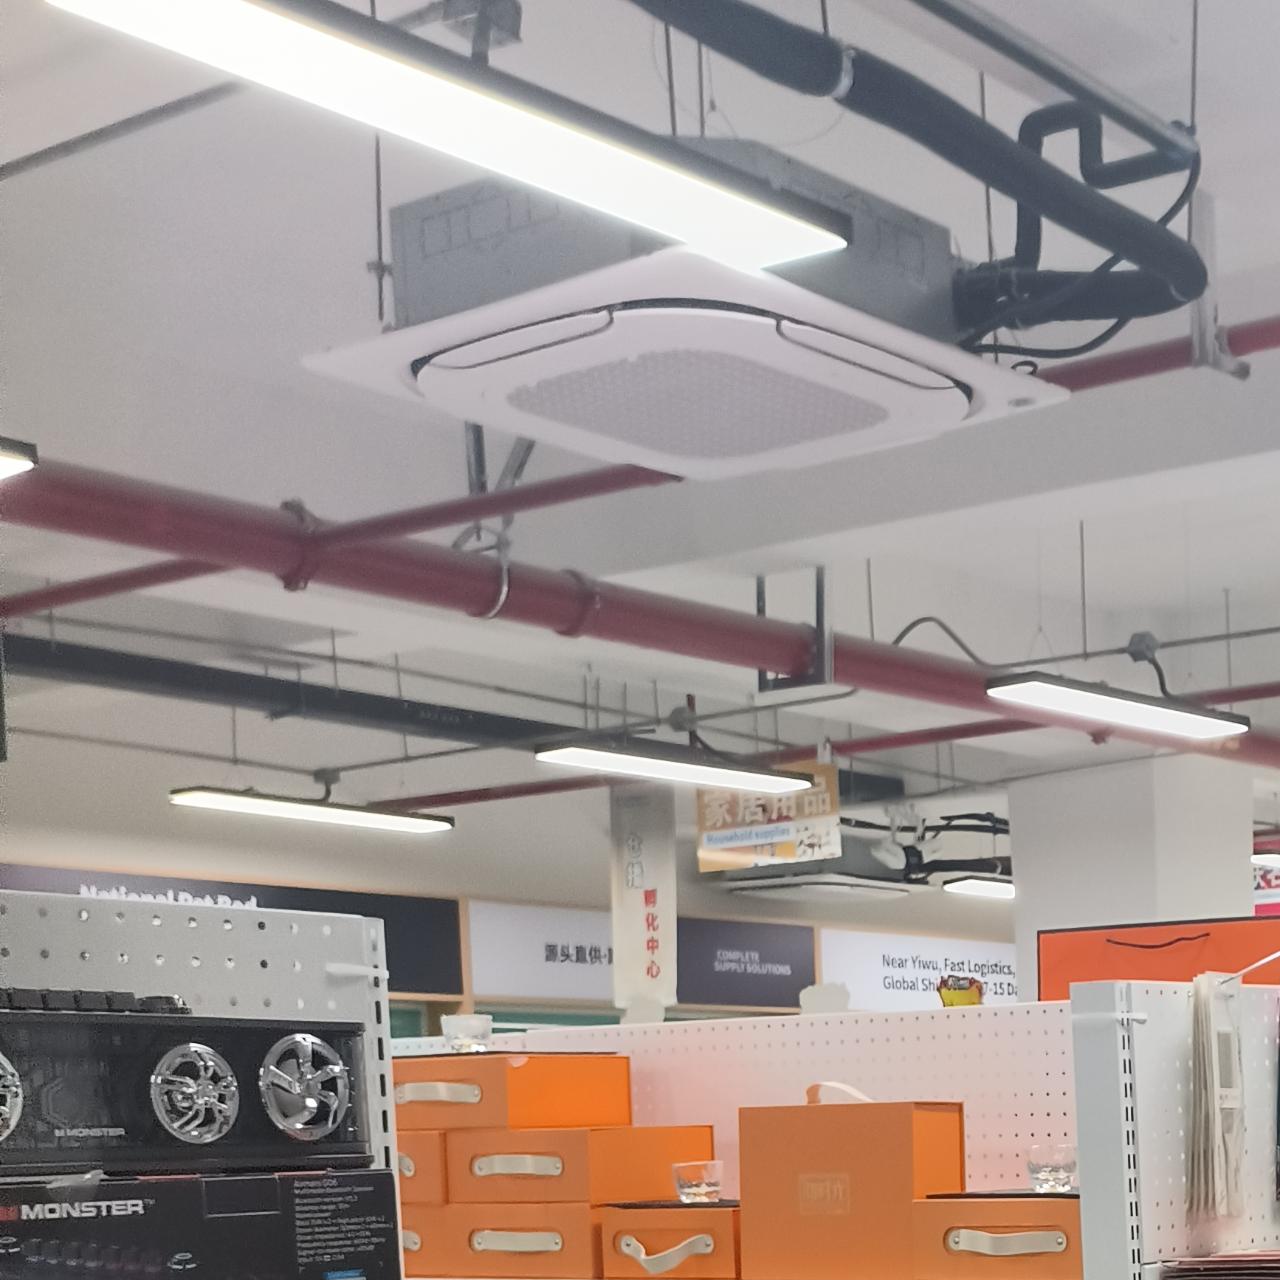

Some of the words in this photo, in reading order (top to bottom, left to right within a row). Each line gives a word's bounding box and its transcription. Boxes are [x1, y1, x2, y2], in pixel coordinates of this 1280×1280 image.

[545, 943, 614, 964] 源头直供·
[746, 963, 792, 976] SOLUTIONS
[882, 954, 908, 969] Near
[911, 955, 942, 974] Yiwu,
[944, 957, 965, 973] Fast
[968, 960, 1016, 978] Logistics,
[883, 976, 919, 991] Global
[21, 1199, 144, 1220] MONSTER
